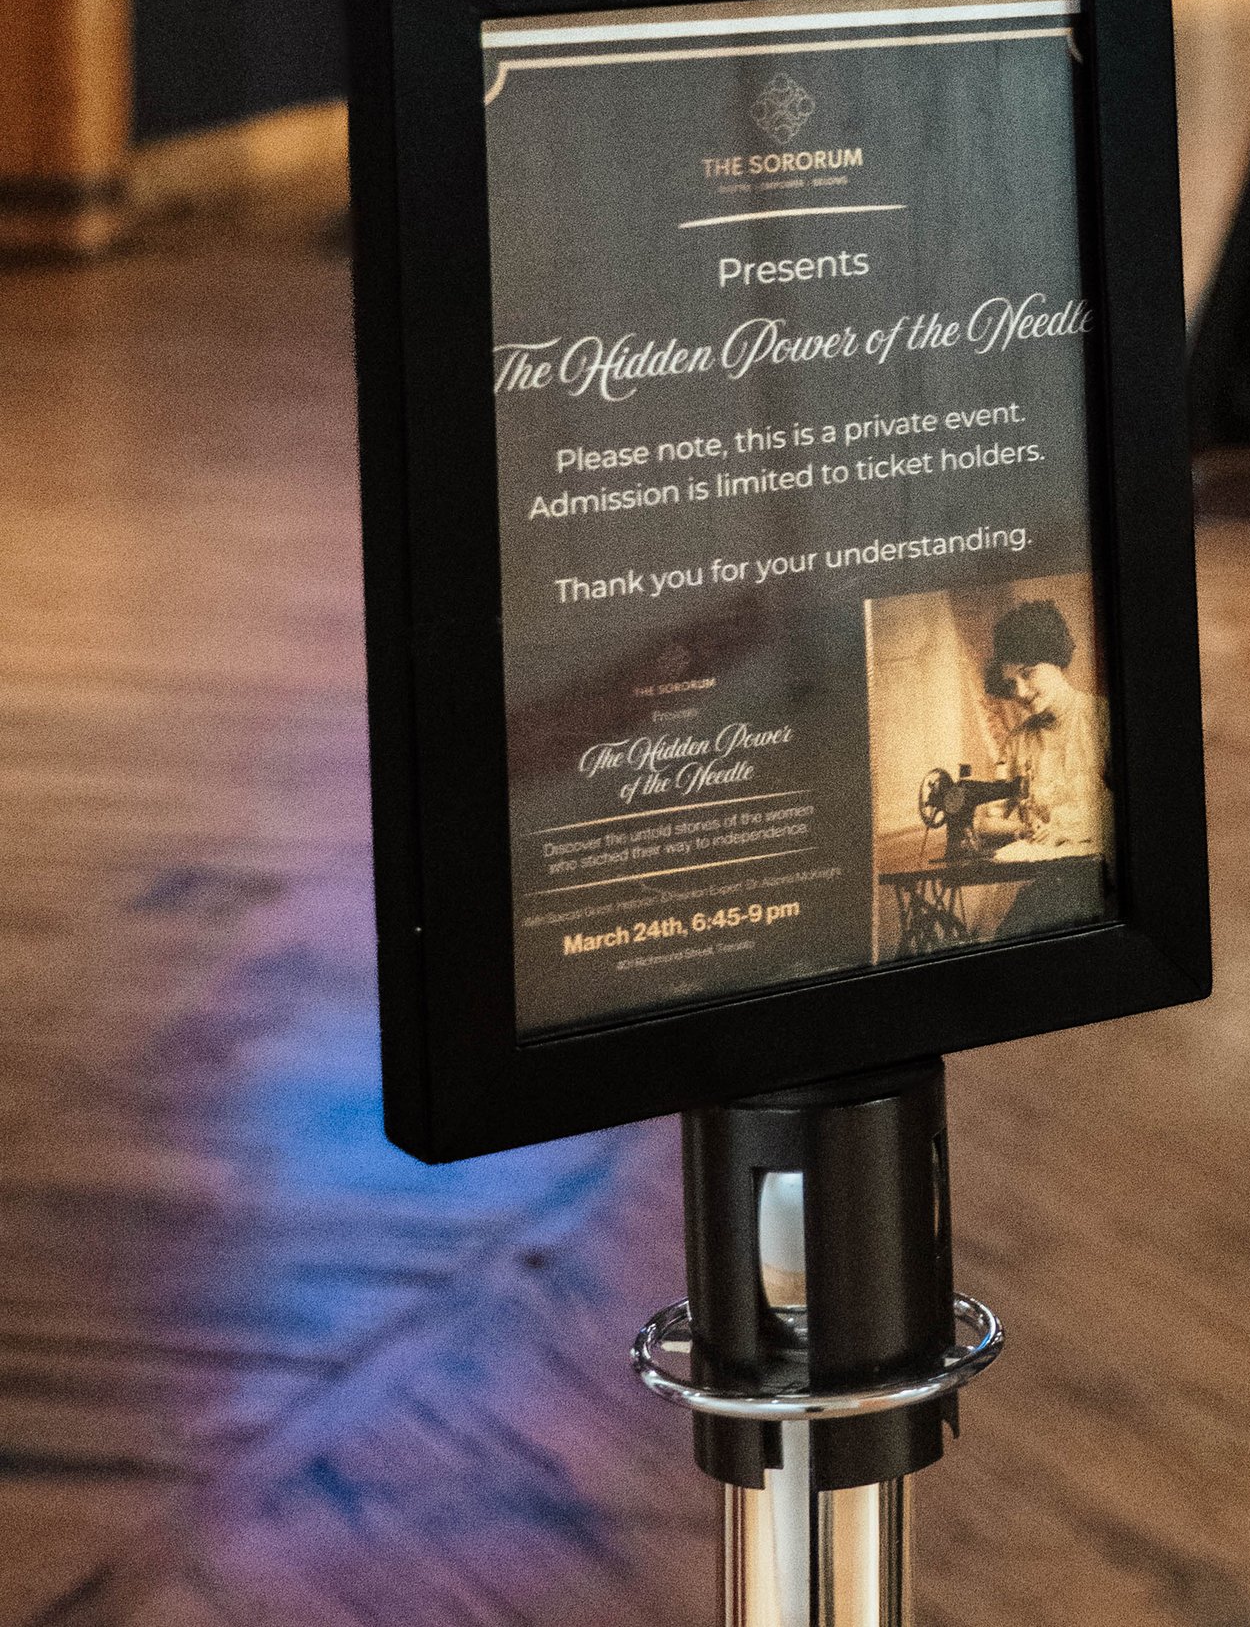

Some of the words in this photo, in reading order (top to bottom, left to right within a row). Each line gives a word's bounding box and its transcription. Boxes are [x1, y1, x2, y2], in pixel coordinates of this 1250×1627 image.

[702, 155, 744, 178] THE
[748, 147, 864, 175] SORORUM
[718, 249, 870, 287] Presents
[493, 337, 561, 394] The
[560, 332, 715, 402] Hidden
[721, 317, 860, 380] Power
[865, 315, 911, 365] of
[907, 312, 960, 351] the
[556, 445, 649, 474] Please
[656, 436, 729, 463] note,
[734, 426, 787, 454] this
[792, 422, 816, 448] is
[821, 423, 838, 445] a
[844, 410, 938, 447] private
[943, 400, 1027, 431] event.
[527, 483, 680, 522] Admission
[687, 475, 710, 501] is
[715, 464, 815, 498] limited
[820, 461, 849, 486] to
[855, 450, 934, 482] ticket
[940, 439, 1046, 473] holders.
[555, 572, 644, 605] Thank
[649, 567, 704, 599] you
[710, 556, 749, 585] for
[754, 551, 818, 583] your
[824, 526, 1034, 570] understanding.
[577, 738, 631, 778] The
[626, 732, 711, 774] Hidden
[714, 722, 793, 760] Power
[619, 775, 642, 805] of
[642, 774, 672, 796] the
[675, 757, 754, 797] Needle
[604, 832, 628, 847] the
[723, 814, 737, 829] of
[740, 812, 762, 826] the
[664, 839, 691, 855] way
[694, 836, 711, 850] to
[562, 924, 631, 957] March
[632, 915, 689, 943] 24th,
[690, 903, 763, 933] 6:45-9
[765, 900, 801, 926] pm
